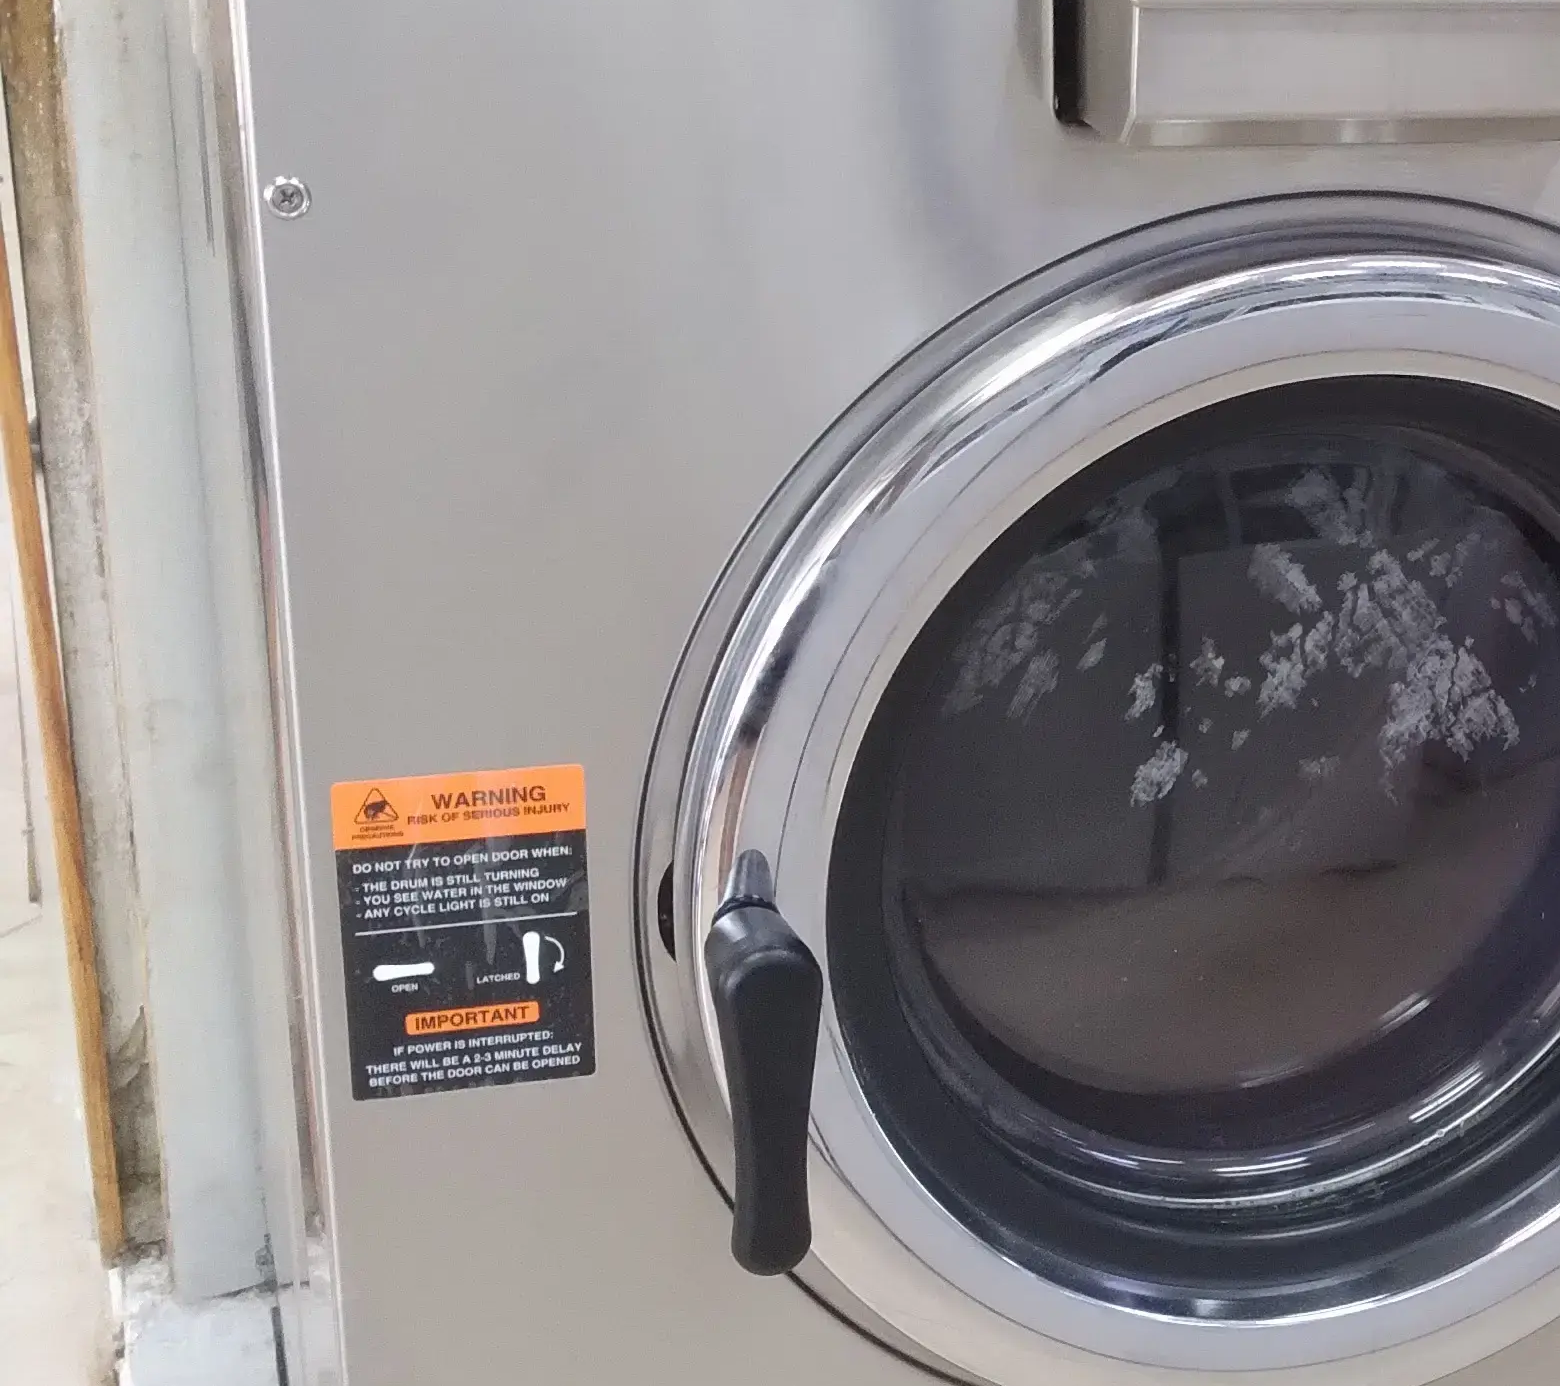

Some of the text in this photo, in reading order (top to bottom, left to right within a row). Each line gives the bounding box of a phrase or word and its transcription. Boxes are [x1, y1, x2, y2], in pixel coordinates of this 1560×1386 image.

[431, 785, 546, 810] WARNING
[407, 802, 570, 825] RISK OF SERIOUS INJURY
[352, 846, 572, 875] DO NOT TRY TO OPEN DOOR WHEN:
[363, 868, 540, 892] THE DRUM IS STILL TURNING
[415, 1006, 530, 1031] IMPORTANT
[393, 1031, 554, 1057] IF POWER IS INTERRUPTED:
[365, 1043, 583, 1075] THERE WILL BE A 2-3 MINUTE DELAY
[369, 1055, 580, 1088] BEFORE THE DOOR CAN BE OPENED
